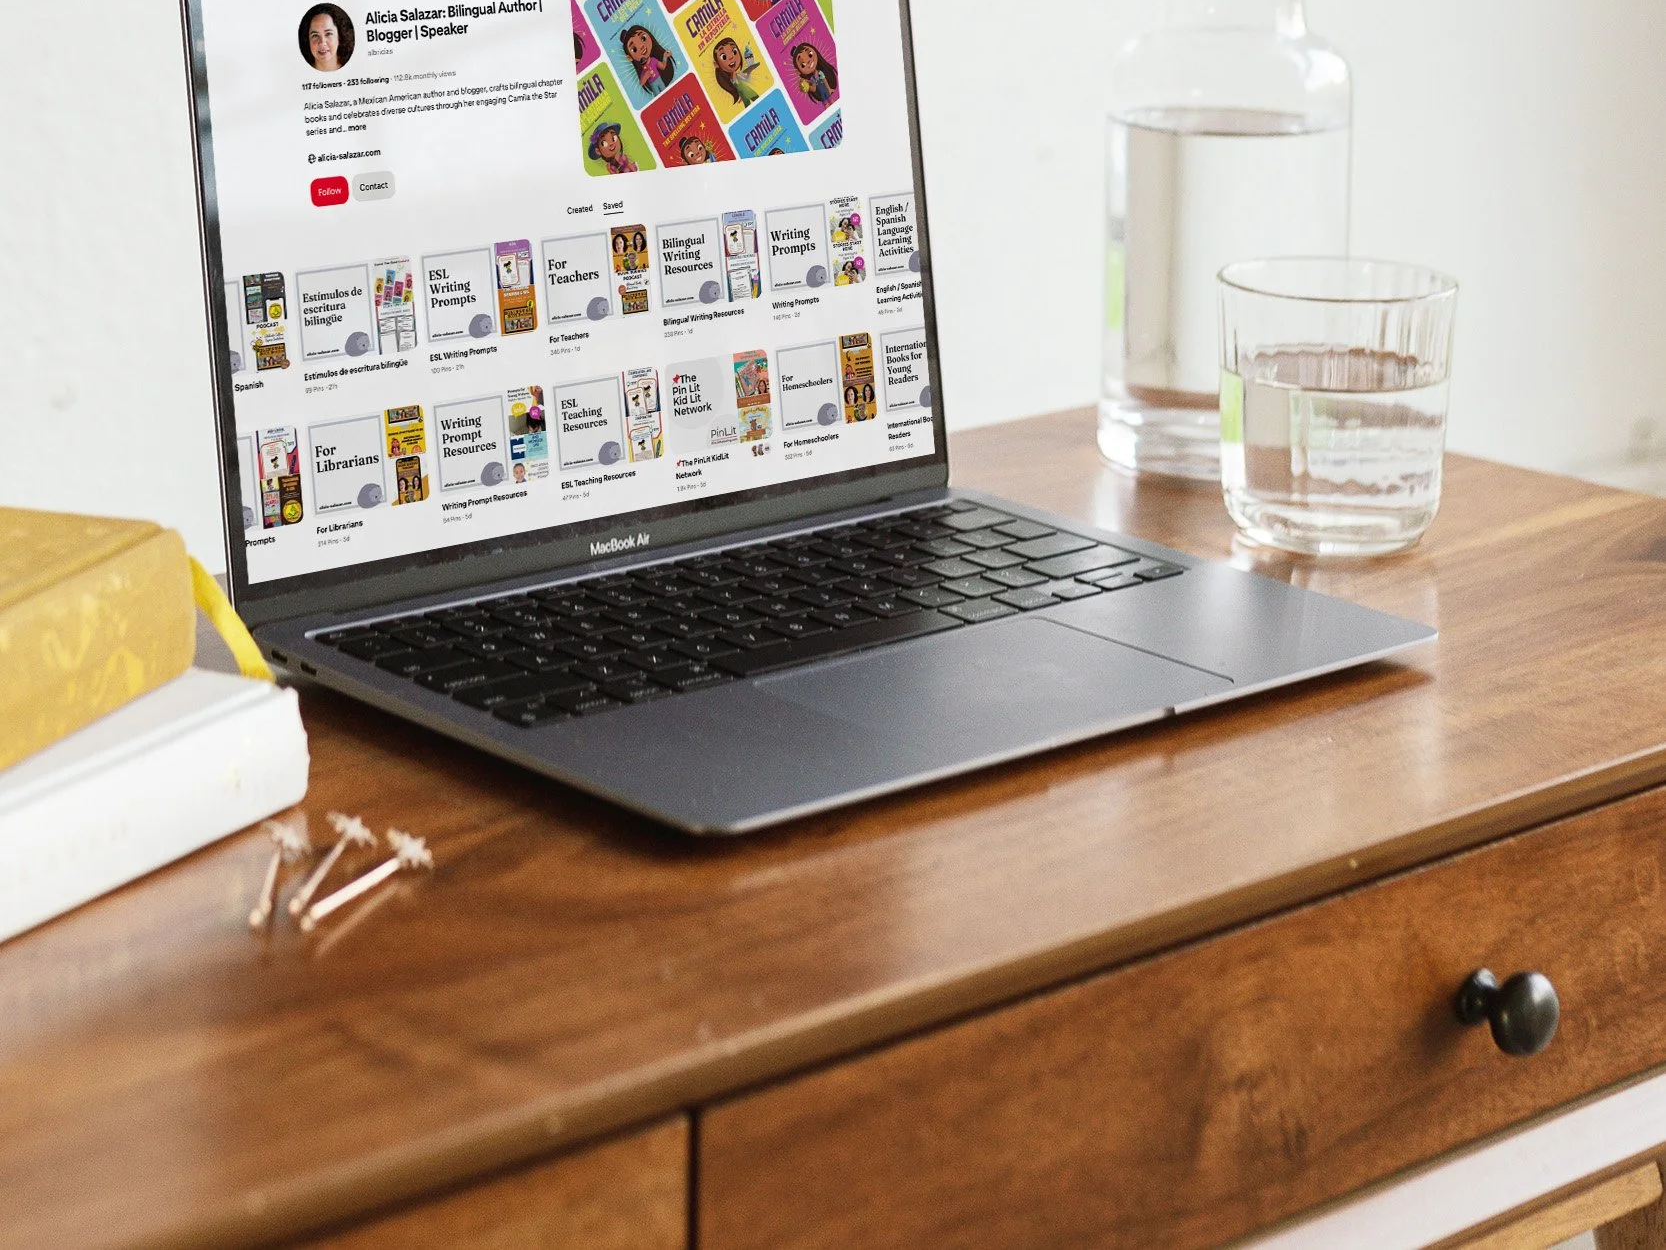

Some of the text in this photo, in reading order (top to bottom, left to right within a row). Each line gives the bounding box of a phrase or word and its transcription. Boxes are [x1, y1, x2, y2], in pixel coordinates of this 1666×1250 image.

[365, 10, 398, 25] Alicia
[399, 7, 446, 22] Salazar:
[447, 1, 496, 18] Bilingual
[497, 0, 537, 13] Author
[366, 28, 413, 43] Blogger
[420, 21, 468, 39] Speaker
[301, 82, 312, 90] 117
[312, 81, 342, 89] followers
[346, 78, 359, 86] 233
[303, 101, 323, 110] Alicia
[324, 99, 352, 109] Salazar,
[358, 96, 387, 105] Mexican
[388, 92, 421, 102] American
[422, 89, 445, 99] author
[446, 88, 459, 96] and
[460, 86, 488, 95] blogger,
[488, 83, 508, 92] crafts
[509, 80, 537, 90] bilingual
[537, 78, 563, 87] chapter
[304, 91, 557, 123] books and celebrates diverse cultures through her engaging Camila the Star
[305, 128, 327, 136] series
[317, 149, 381, 162] alicia-salazar.com
[317, 187, 341, 196] Follow
[359, 181, 388, 191] Contact
[566, 204, 593, 215] Created
[602, 200, 623, 210] Saved
[875, 203, 903, 216] English
[875, 213, 906, 227] Spanish
[769, 227, 810, 241] Writing
[876, 224, 913, 236] Language
[662, 233, 705, 249] Bilingual
[877, 235, 912, 246] Learning
[662, 247, 701, 262] Writing
[771, 242, 816, 256] Prompts
[878, 245, 914, 257] Activities
[547, 258, 567, 271] For
[664, 261, 713, 275] Resources
[428, 268, 449, 281] ESL
[548, 269, 599, 285] Teachers
[429, 280, 471, 294] Writing
[875, 284, 896, 294] English
[302, 286, 362, 303] Estímulos de
[430, 294, 476, 308] Prompts
[876, 295, 901, 304] Learning
[303, 302, 346, 315] escritura
[771, 296, 819, 309] Writing Prompts
[303, 313, 342, 326] bilingüe
[662, 308, 744, 326] Bilingual Writing Resources
[549, 332, 589, 343] For Teachers
[429, 346, 497, 362] ESL Writing Prompts
[886, 351, 922, 364] Books for
[303, 358, 408, 381] Estímulos de escritura bilingüe
[886, 364, 912, 374] Young
[679, 373, 696, 384] The
[781, 374, 793, 382] For
[782, 377, 833, 391] Homeschoolers
[887, 372, 919, 385] Readers
[234, 380, 264, 392] Spanish
[672, 382, 700, 396] Pin Lit
[560, 398, 578, 409] ESL
[672, 392, 701, 406] Kid Lit
[561, 406, 602, 420] Teaching
[673, 401, 712, 417] Network
[440, 415, 481, 430] Writing
[562, 418, 607, 432] Resources
[886, 416, 922, 429] International
[442, 429, 482, 444] Prompt
[710, 426, 736, 438] PinLit
[887, 431, 911, 440] Readers
[793, 433, 839, 446] Homeschoolers
[314, 445, 336, 458] For
[442, 441, 497, 458] Resources
[315, 454, 379, 473] Librarians
[681, 452, 729, 467] The PinLit KidLit
[560, 470, 636, 489] ESL Teaching Resources
[675, 468, 702, 479] Network
[441, 490, 527, 511] Writing Prompt Resources
[316, 520, 363, 534] For Librarians
[245, 536, 275, 548] Prompts
[590, 532, 650, 556] MacBook Air
